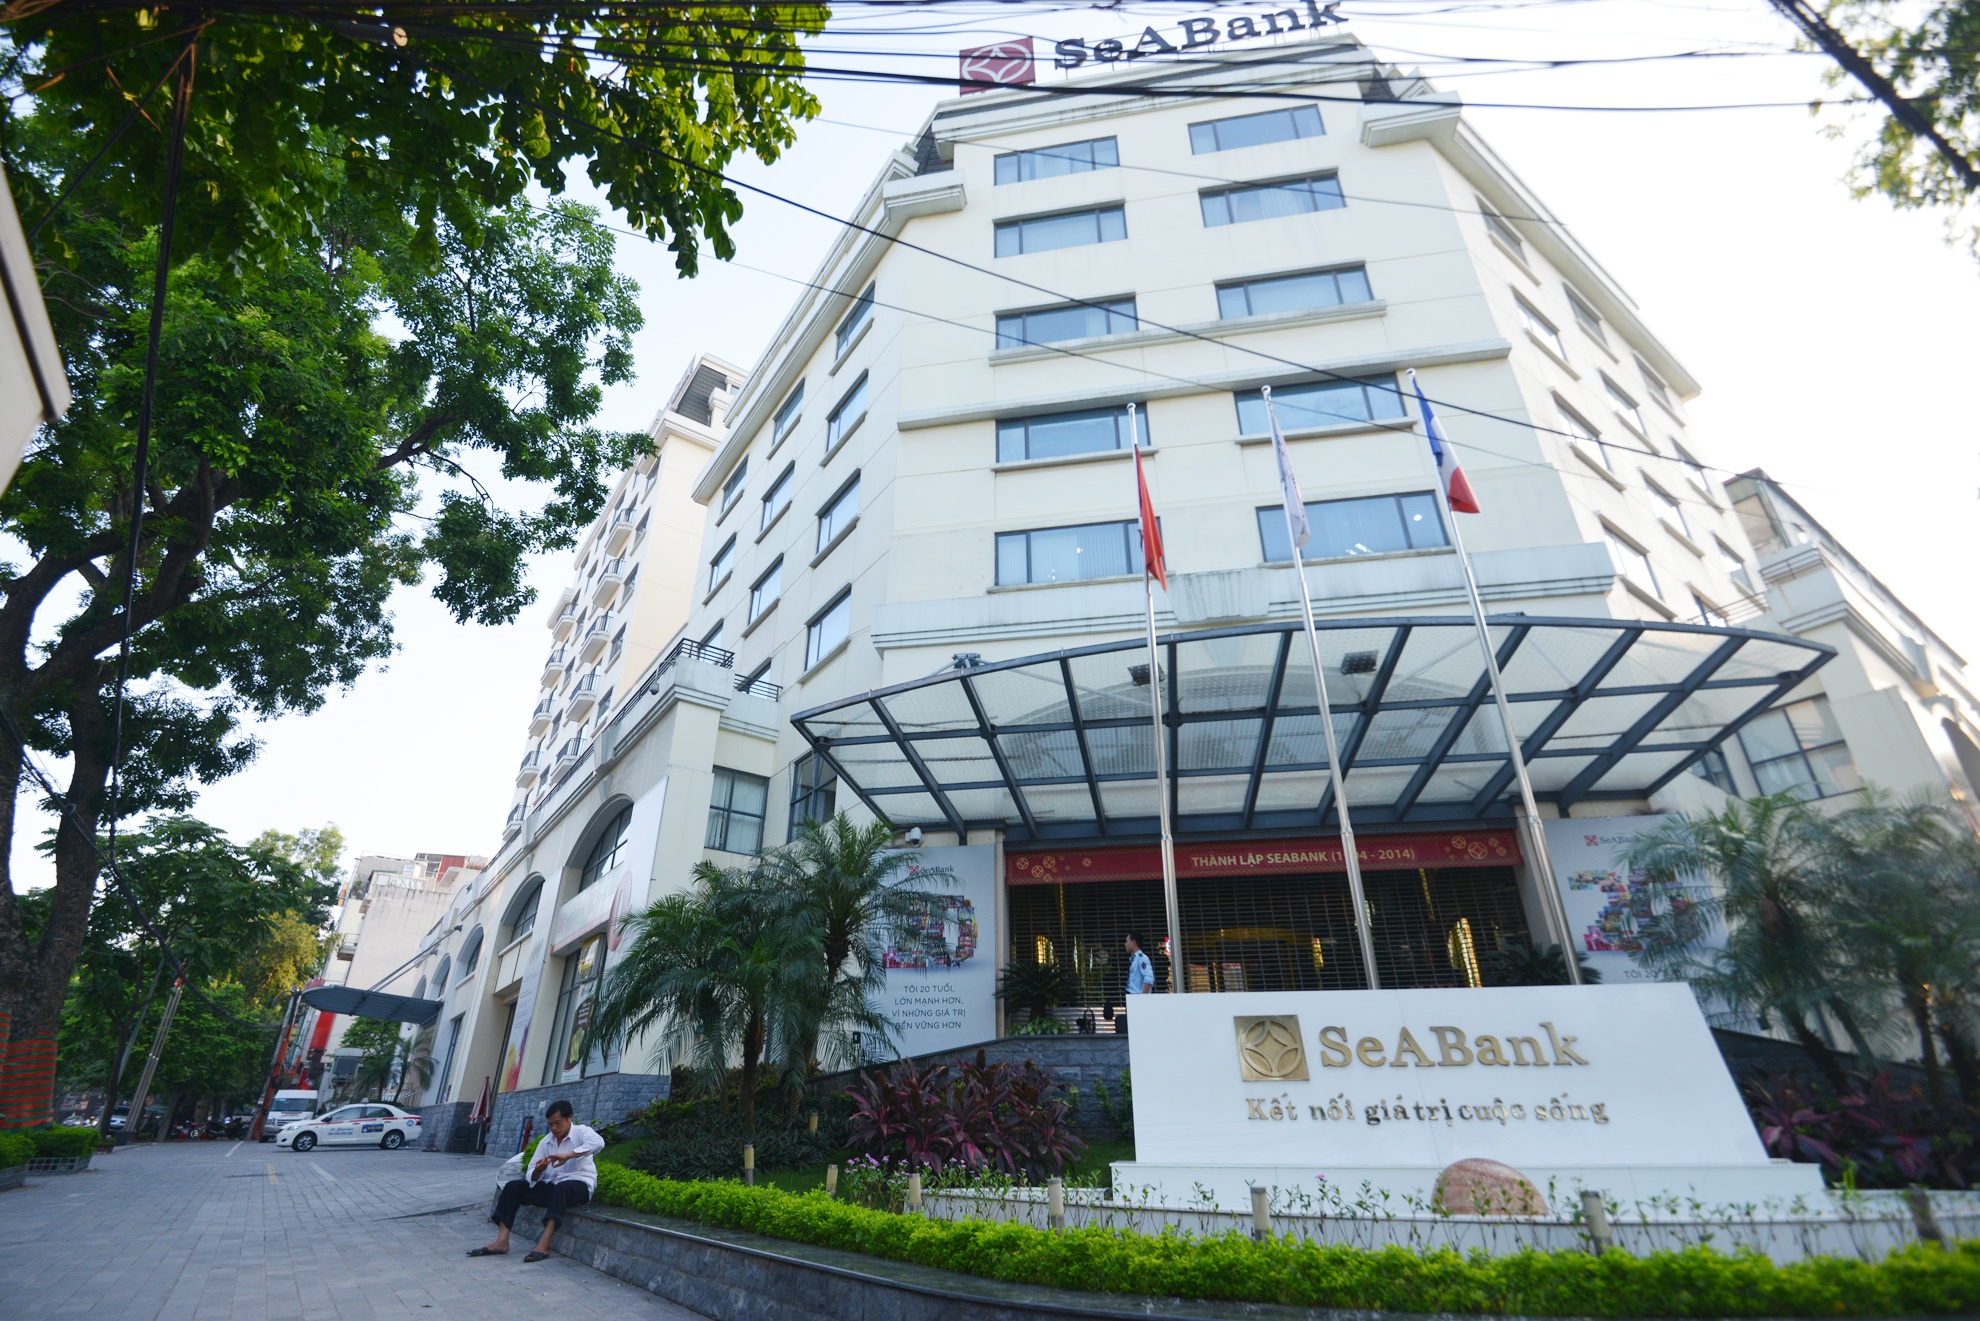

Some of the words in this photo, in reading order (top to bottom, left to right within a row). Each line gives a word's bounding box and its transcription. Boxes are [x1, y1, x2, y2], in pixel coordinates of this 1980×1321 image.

[1055, 0, 1348, 69] SeABank
[1192, 854, 1237, 867] THÀNH
[1240, 853, 1264, 868] LẬP
[1266, 851, 1328, 864] SEABANK
[1331, 850, 1368, 863] (14
[1378, 848, 1415, 860] 2014)
[904, 984, 918, 993] TÔI
[920, 985, 931, 993] 20
[894, 997, 912, 1005] LỚN
[914, 997, 940, 1006] MẠNH
[891, 1009, 900, 1017] VÌ
[902, 1009, 933, 1017] NHỮNG
[935, 1008, 950, 1017] GIÁ
[942, 1021, 962, 1029] HƠN
[1319, 1022, 1588, 1067] SeABank
[1246, 1092, 1298, 1120] Kết
[1308, 1092, 1355, 1120] nối
[1364, 1093, 1410, 1125] giá
[1413, 1097, 1453, 1127] trị
[1458, 1097, 1526, 1126] cuộc
[1534, 1092, 1609, 1124] sống
